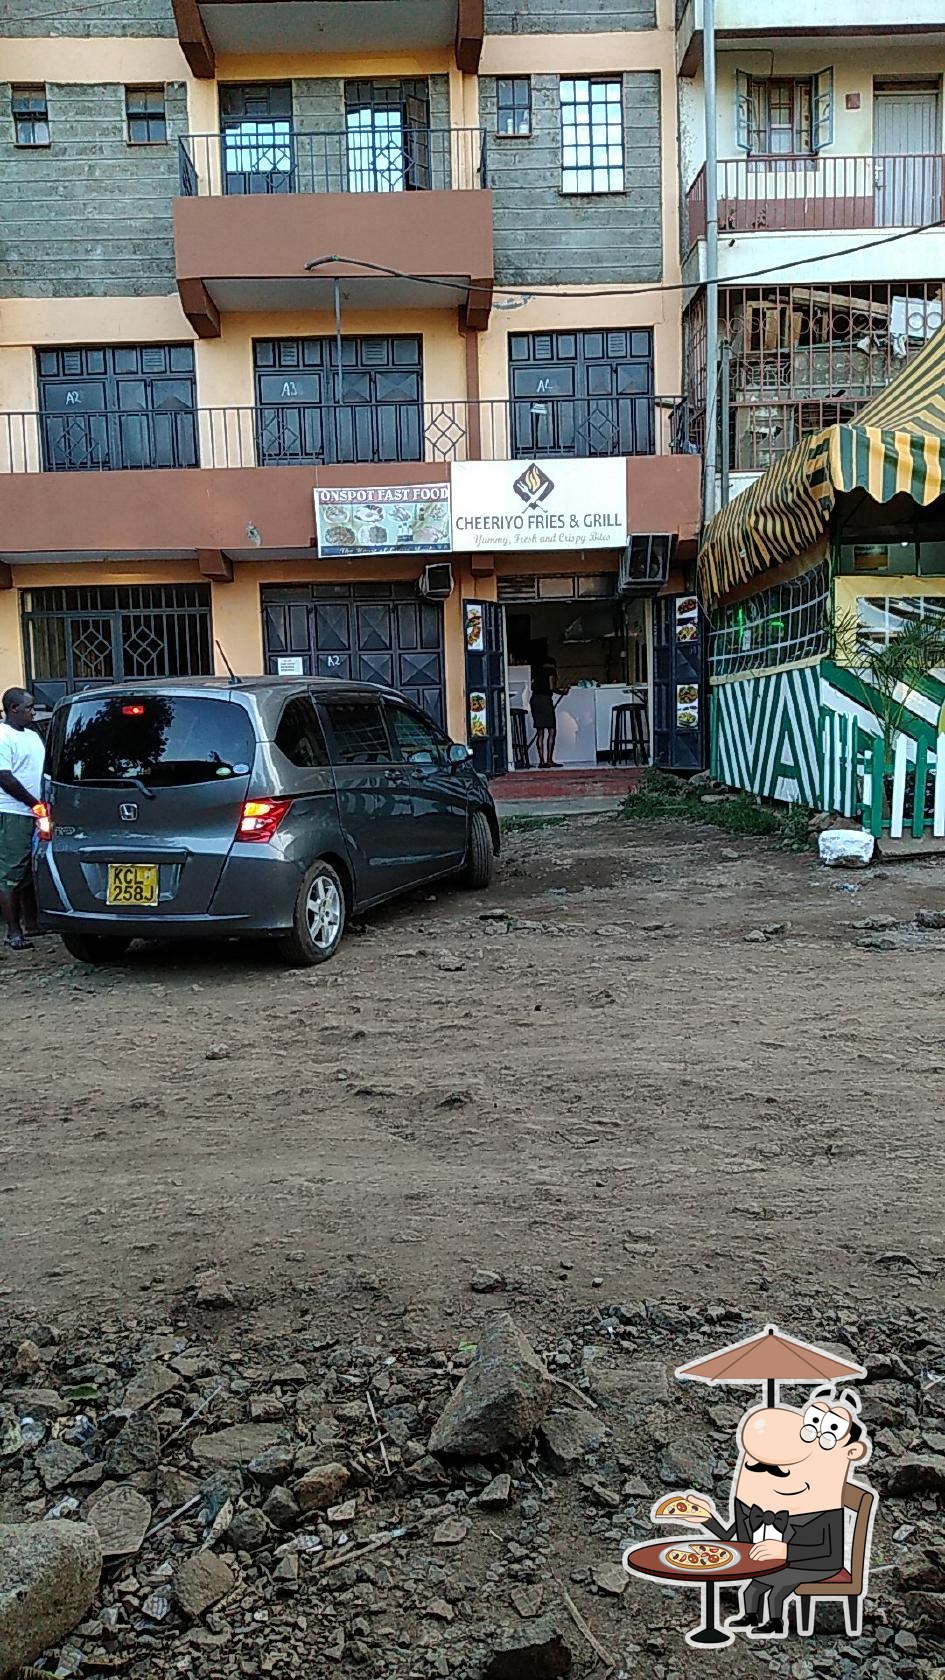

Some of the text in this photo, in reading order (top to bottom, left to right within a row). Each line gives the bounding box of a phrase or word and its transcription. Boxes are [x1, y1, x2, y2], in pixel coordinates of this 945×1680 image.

[281, 381, 298, 397] A3
[65, 391, 82, 405] A2
[320, 487, 449, 501] ONSPOT FAST FOOD
[455, 512, 622, 530] CHEERIYO FRIES & GRILL
[473, 531, 611, 547] Yummy, Fresh and Crispy Bites
[327, 655, 341, 667] A2
[113, 868, 144, 886] KCL
[113, 885, 154, 901] 258J
